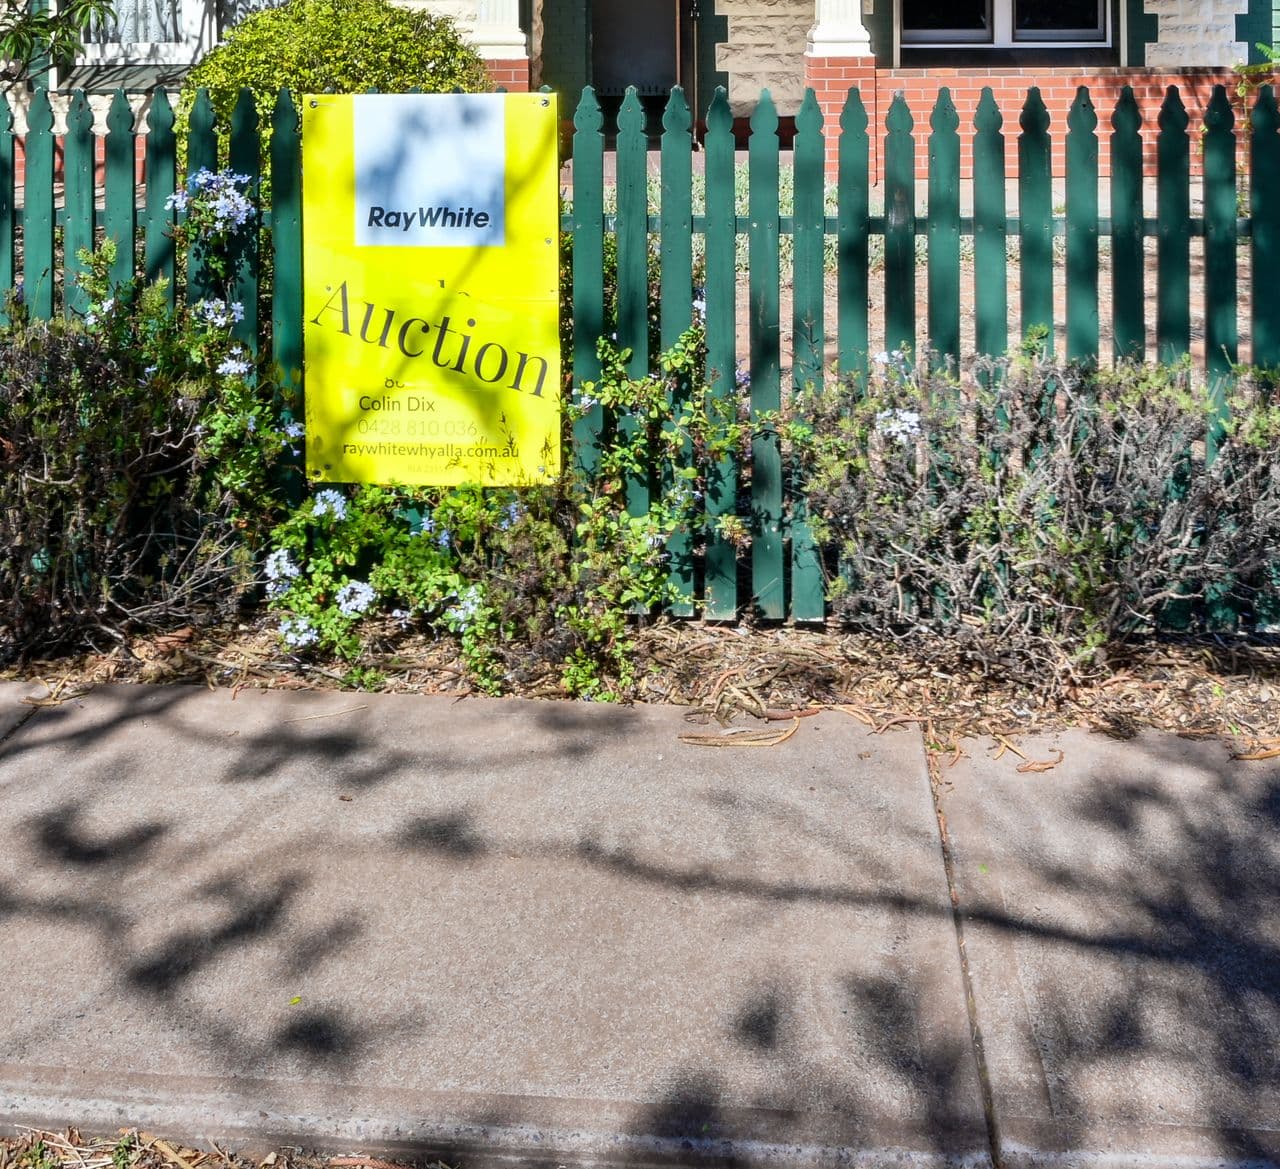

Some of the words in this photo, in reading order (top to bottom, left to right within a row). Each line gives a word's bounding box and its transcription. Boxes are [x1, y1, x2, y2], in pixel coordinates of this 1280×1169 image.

[310, 280, 549, 399] Auction
[359, 395, 401, 412] Colin
[407, 396, 436, 412] Dix
[357, 419, 399, 435] 0428
[407, 419, 439, 435] 810
[343, 443, 519, 459] raywhitewhyalla.com.au
